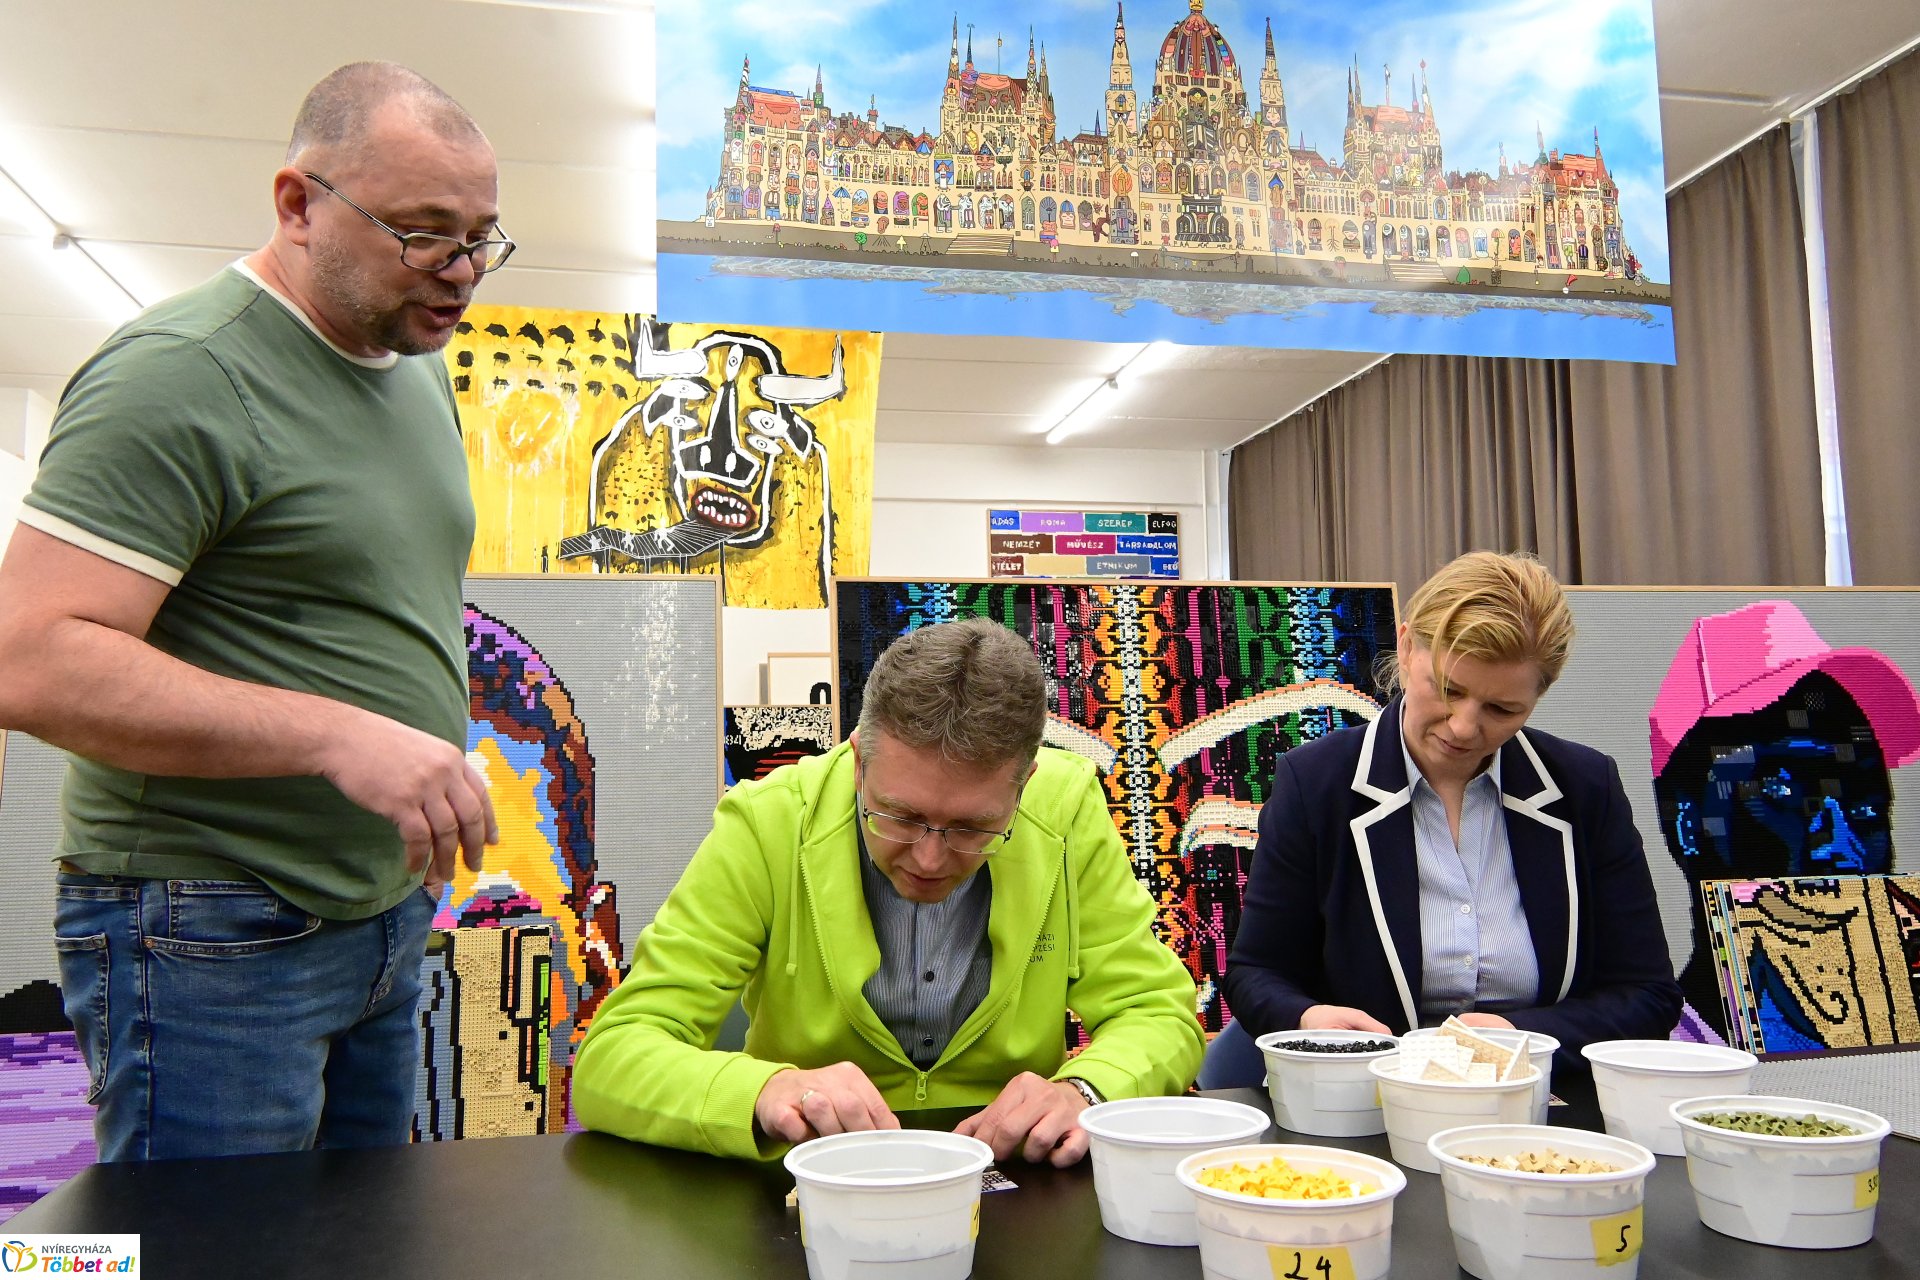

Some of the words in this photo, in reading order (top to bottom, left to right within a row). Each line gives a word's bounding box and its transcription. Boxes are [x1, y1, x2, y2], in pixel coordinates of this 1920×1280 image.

[1097, 519, 1133, 528] SZEREP
[1096, 562, 1138, 571] ETNIKUM
[1615, 1224, 1632, 1253] 5
[1283, 1251, 1332, 1280] 24
